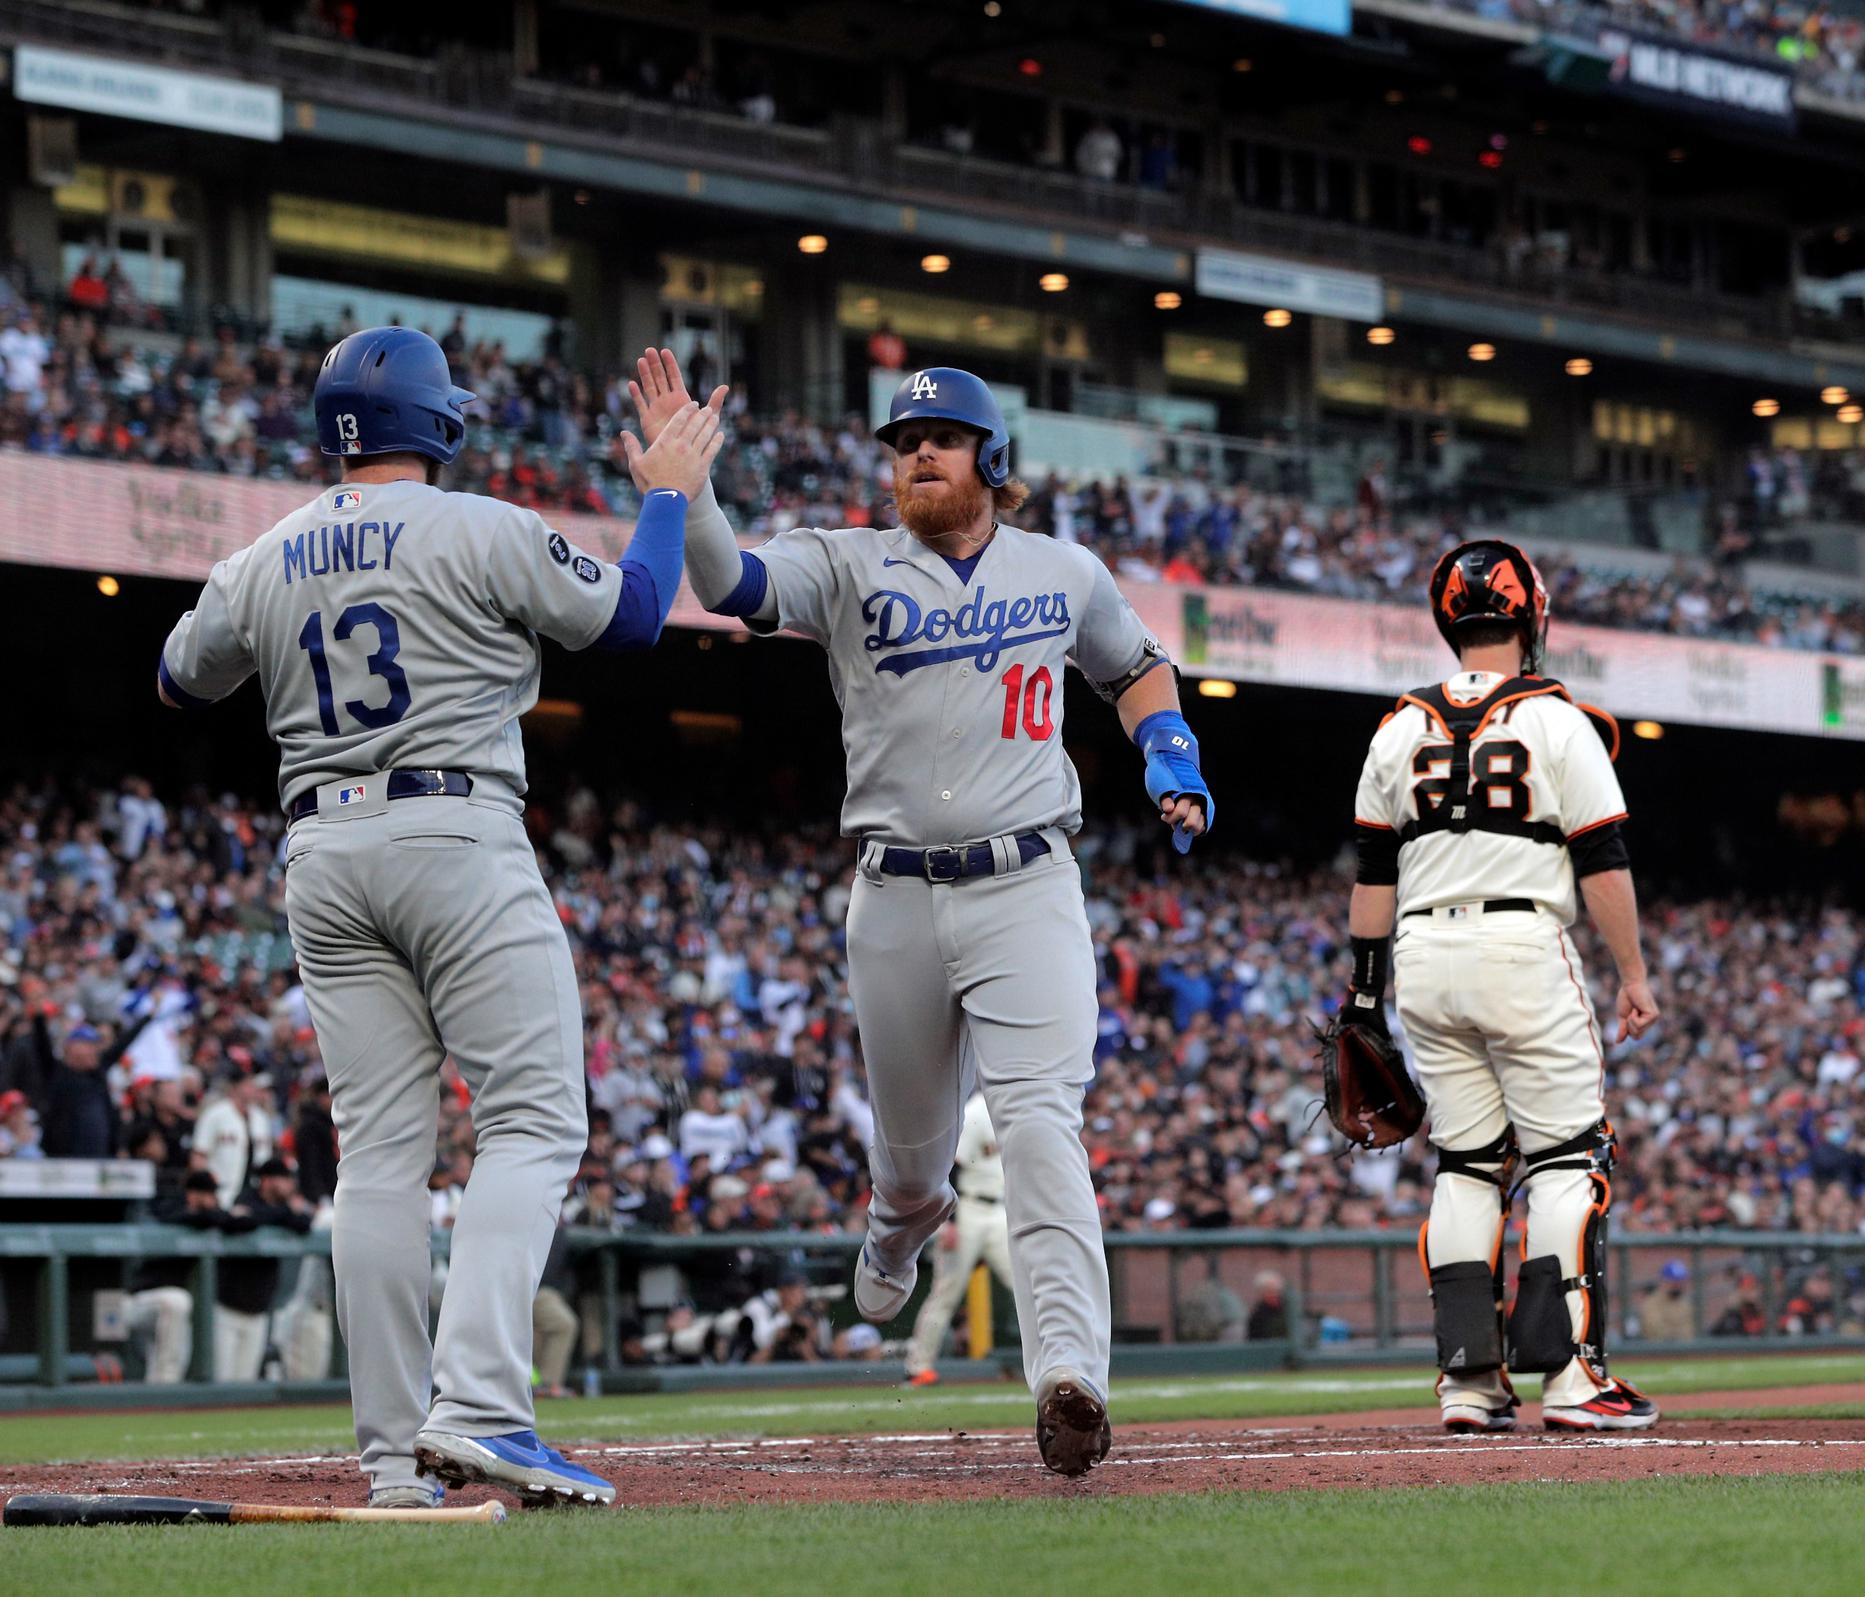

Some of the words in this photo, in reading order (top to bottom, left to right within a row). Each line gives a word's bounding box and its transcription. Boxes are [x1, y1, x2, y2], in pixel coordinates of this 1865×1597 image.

[911, 371, 937, 400] LA
[336, 413, 359, 440] 13
[283, 521, 405, 585] MUNCY
[861, 585, 1071, 674] Dodgers
[299, 602, 412, 737] 13
[1001, 663, 1054, 741] 10
